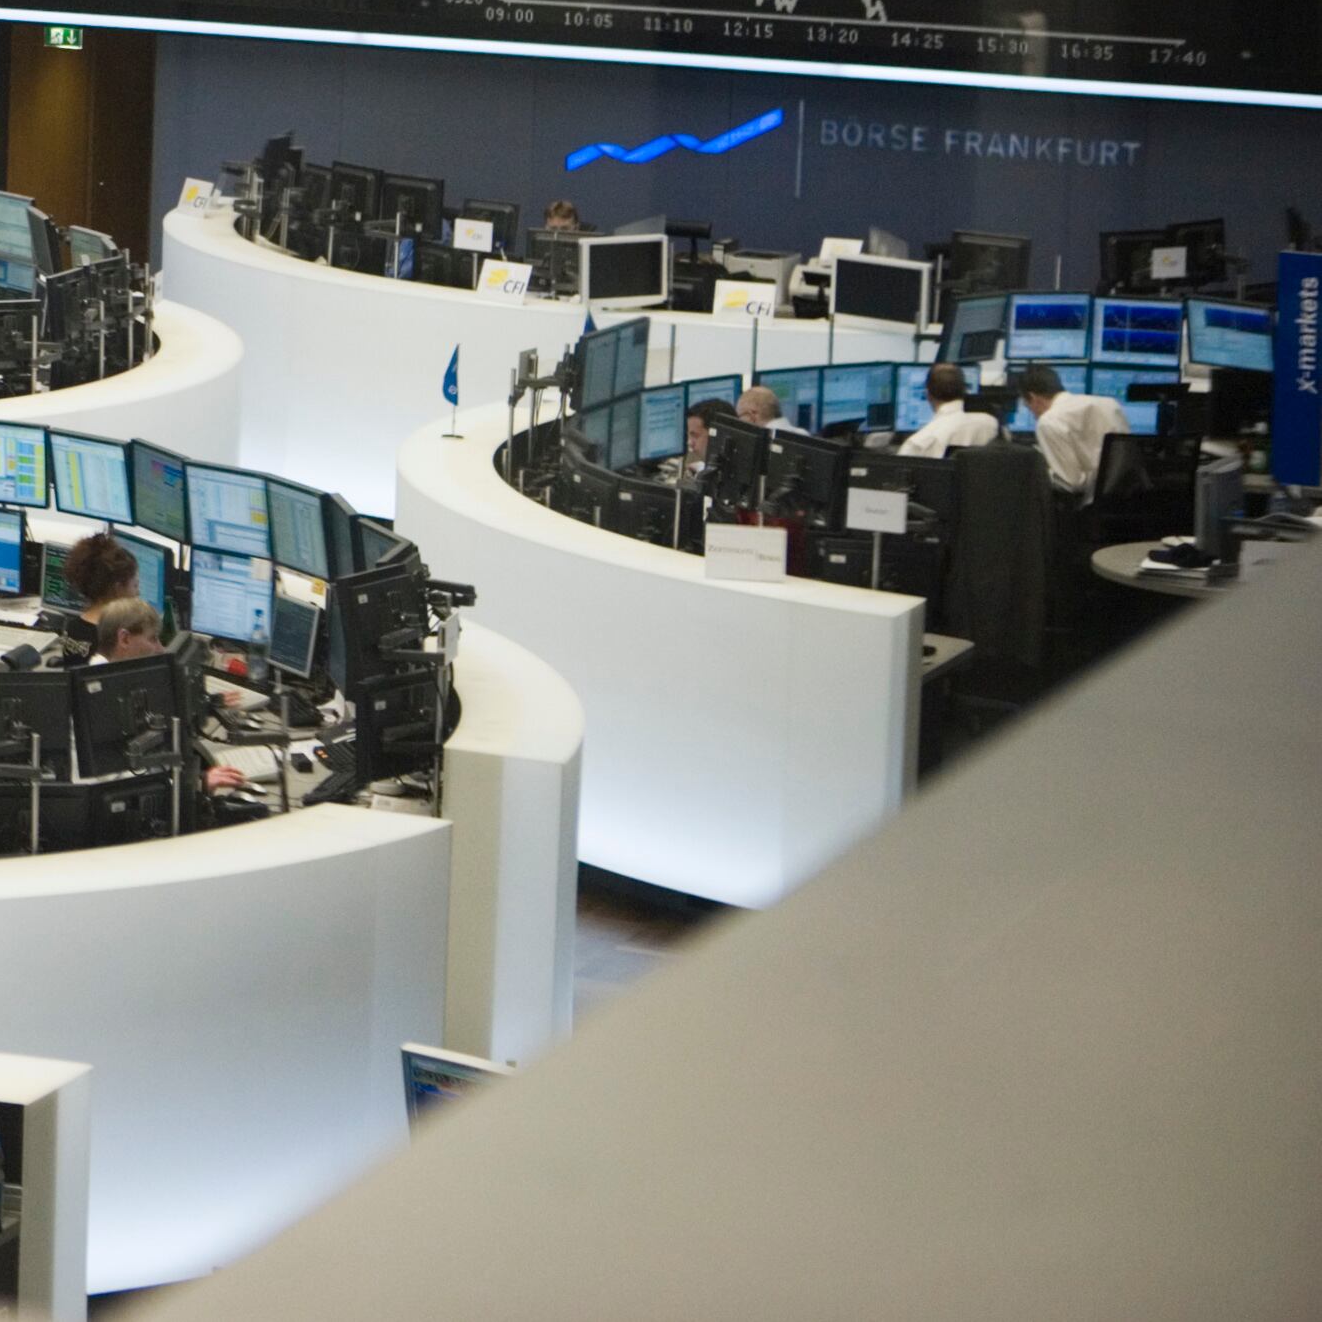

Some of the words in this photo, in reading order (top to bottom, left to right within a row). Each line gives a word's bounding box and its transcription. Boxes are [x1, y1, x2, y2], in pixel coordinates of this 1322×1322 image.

[485, 8, 534, 23] 09:00
[564, 12, 613, 28] 10:05
[723, 22, 774, 38] 12:15
[807, 27, 858, 43] 13:20
[891, 32, 944, 49] 14:25
[1149, 47, 1206, 66] 17:40
[944, 129, 1143, 168] FRANKFURT
[1294, 277, 1319, 394] x-markets
